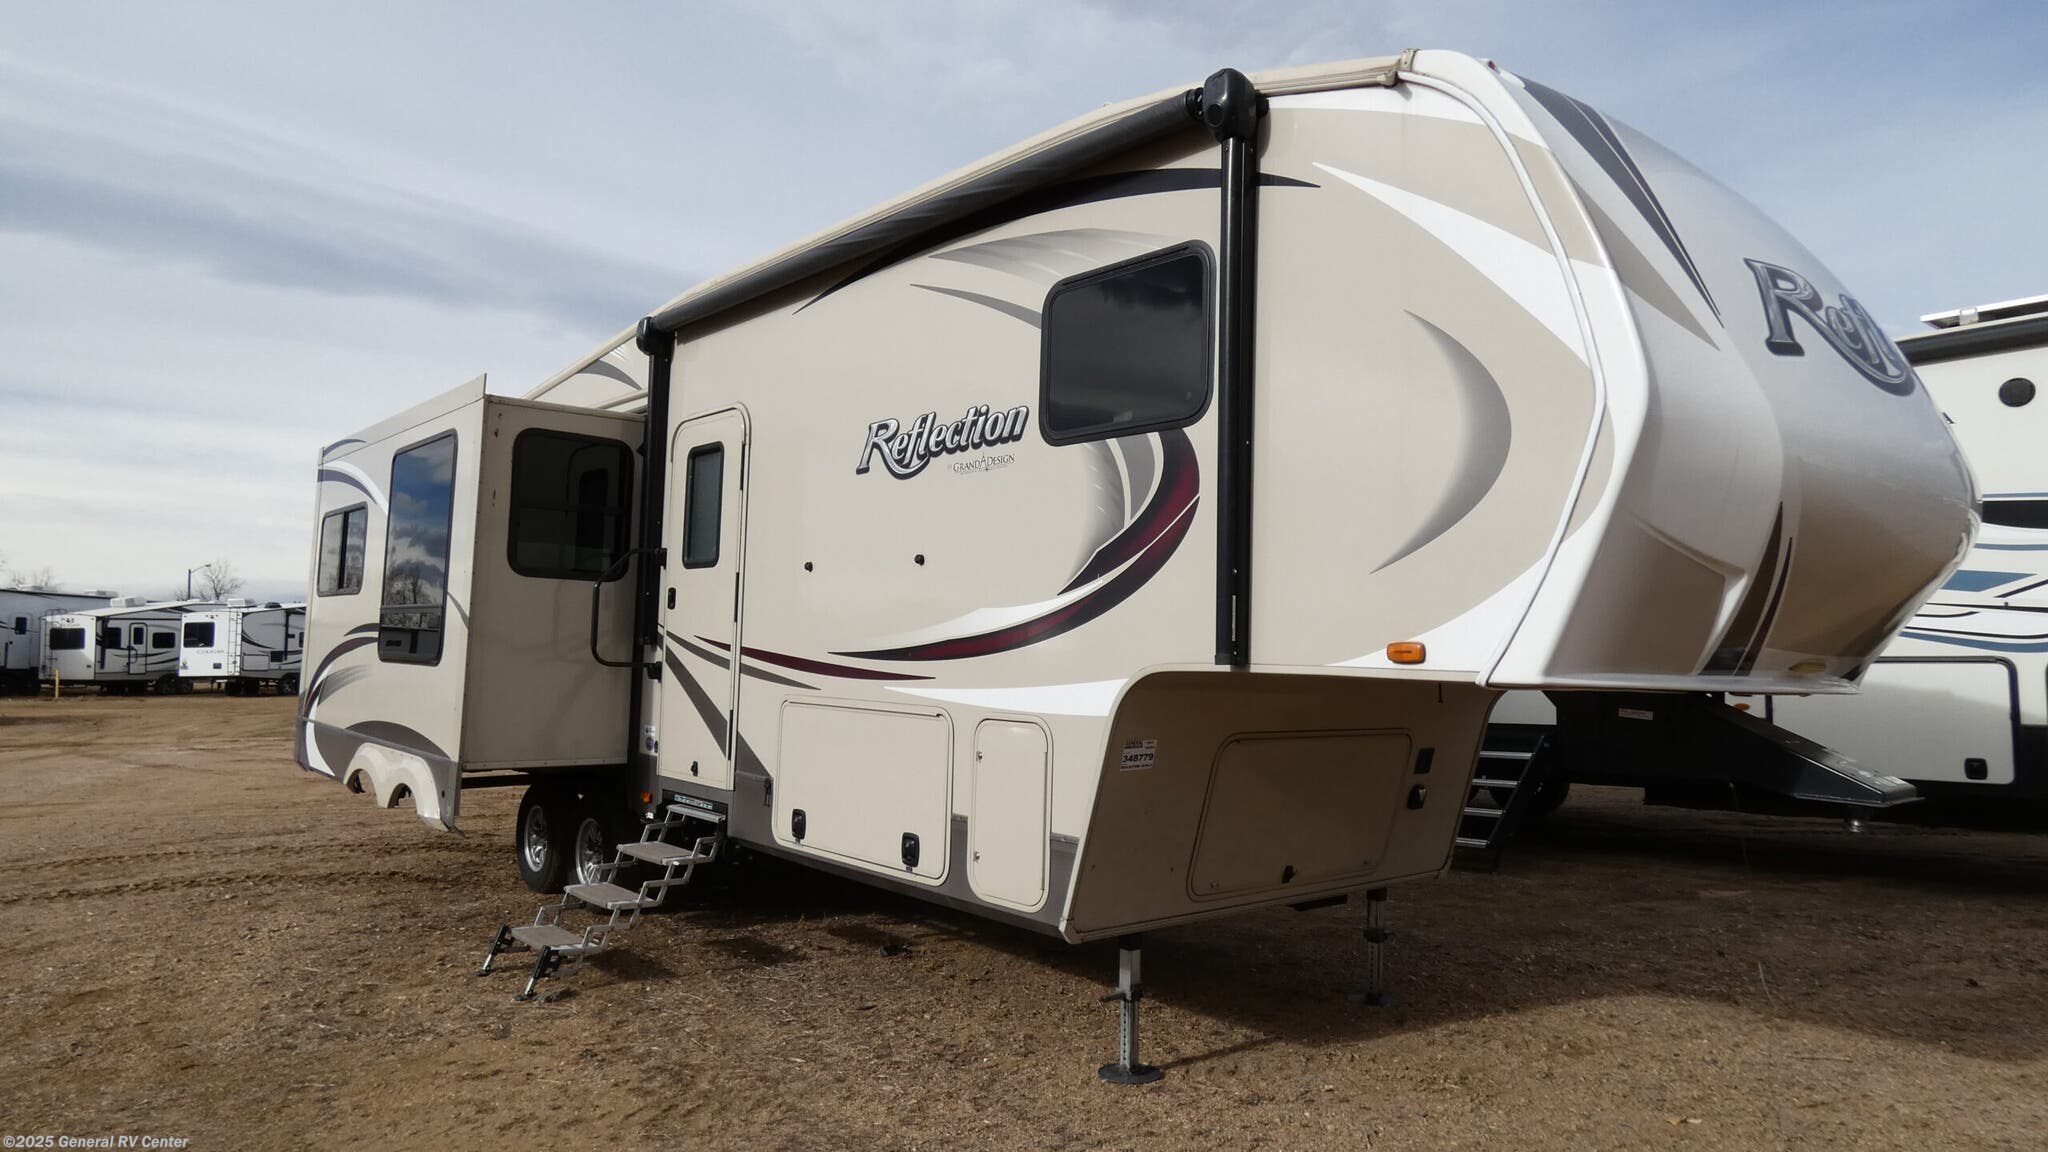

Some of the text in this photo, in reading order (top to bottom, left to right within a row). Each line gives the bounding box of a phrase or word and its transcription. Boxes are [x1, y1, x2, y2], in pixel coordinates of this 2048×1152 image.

[856, 404, 1029, 480] Reflection
[953, 459, 980, 473] GRAND
[987, 453, 1015, 467] DESIGN
[1122, 752, 1154, 763] 348779
